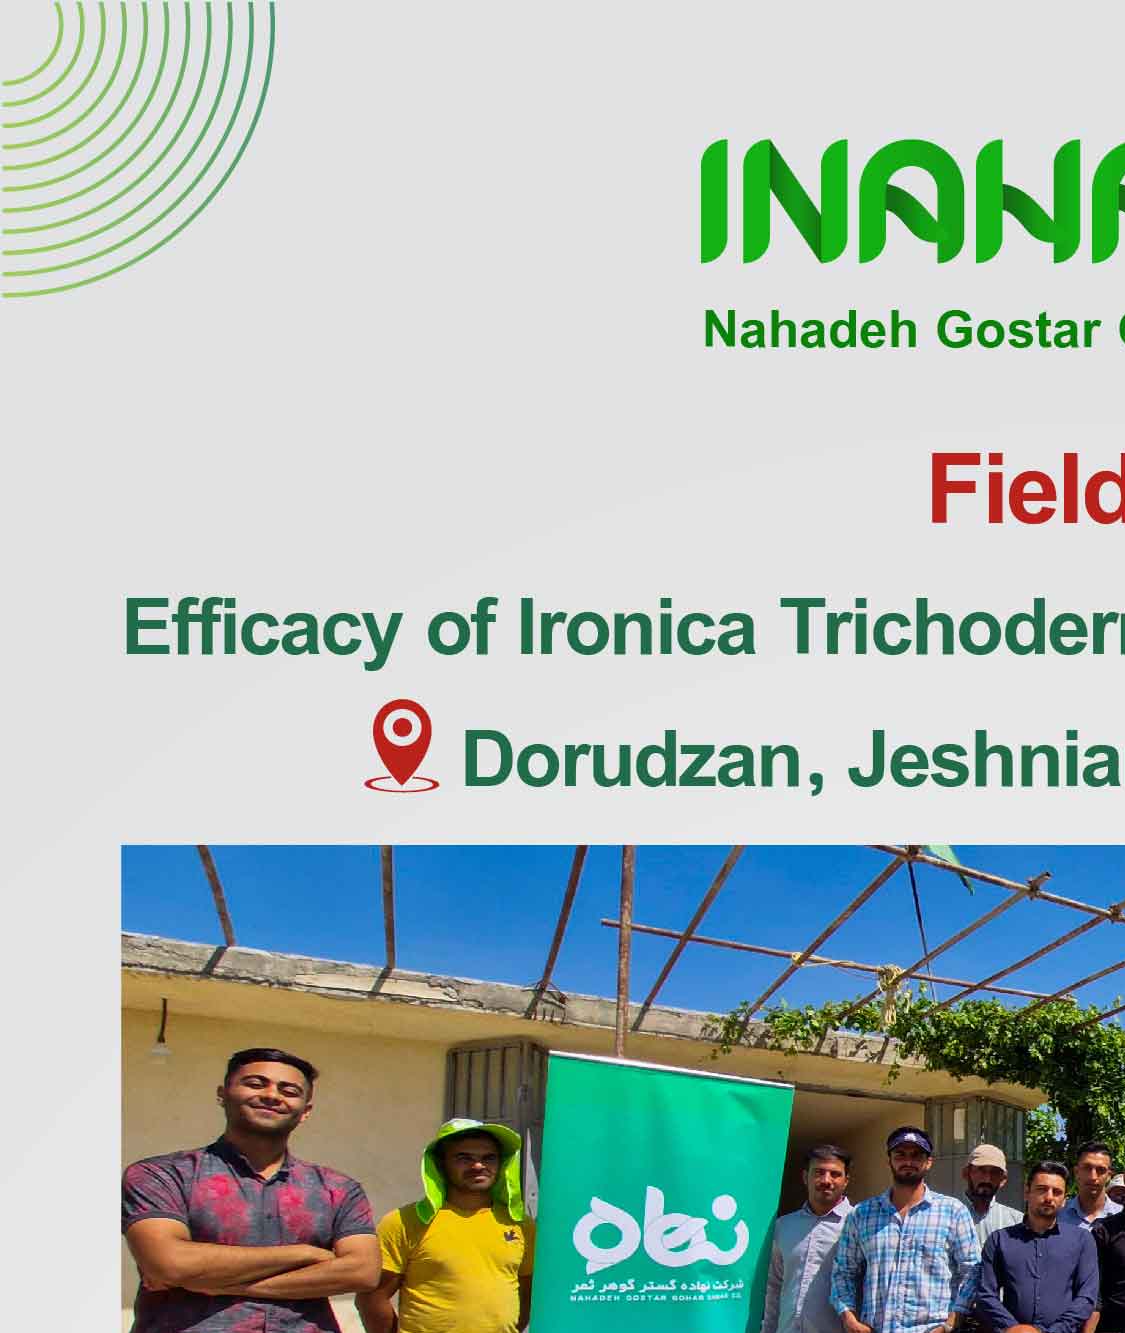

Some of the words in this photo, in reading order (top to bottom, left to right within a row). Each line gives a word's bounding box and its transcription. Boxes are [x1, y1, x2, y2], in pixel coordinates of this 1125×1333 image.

[599, 1279, 635, 1293] گوهر
[639, 1279, 677, 1293] گستر
[680, 1281, 711, 1293] نهاده
